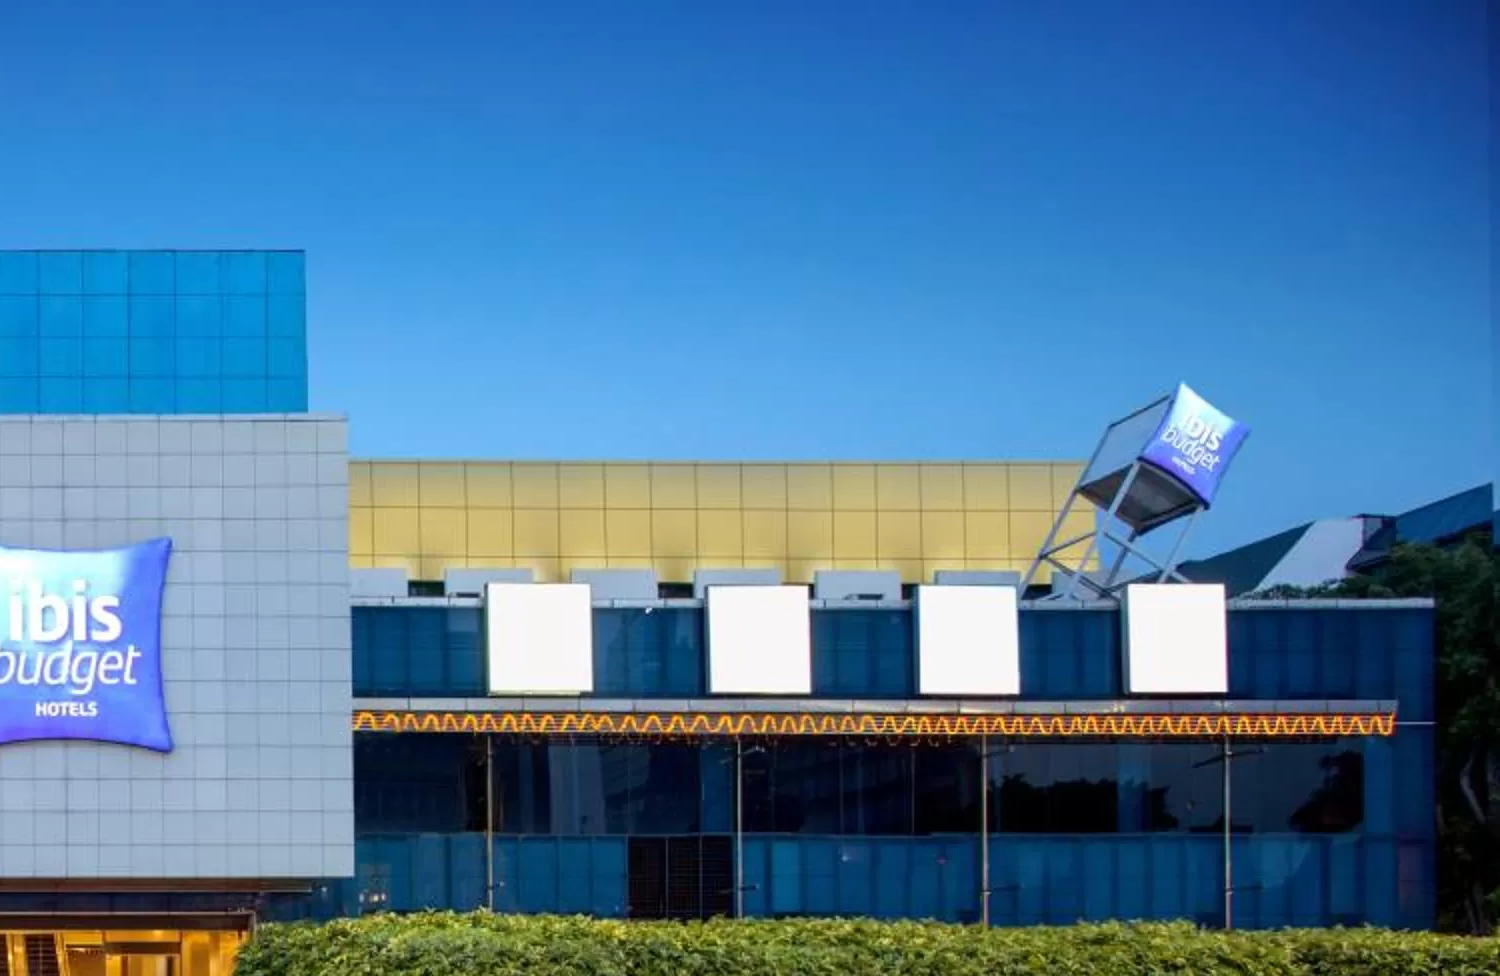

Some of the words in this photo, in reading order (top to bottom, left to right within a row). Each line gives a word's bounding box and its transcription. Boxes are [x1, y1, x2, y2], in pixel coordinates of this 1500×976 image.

[1161, 424, 1220, 472] budget
[9, 577, 122, 642] ibis
[35, 701, 99, 717] HOTELS
